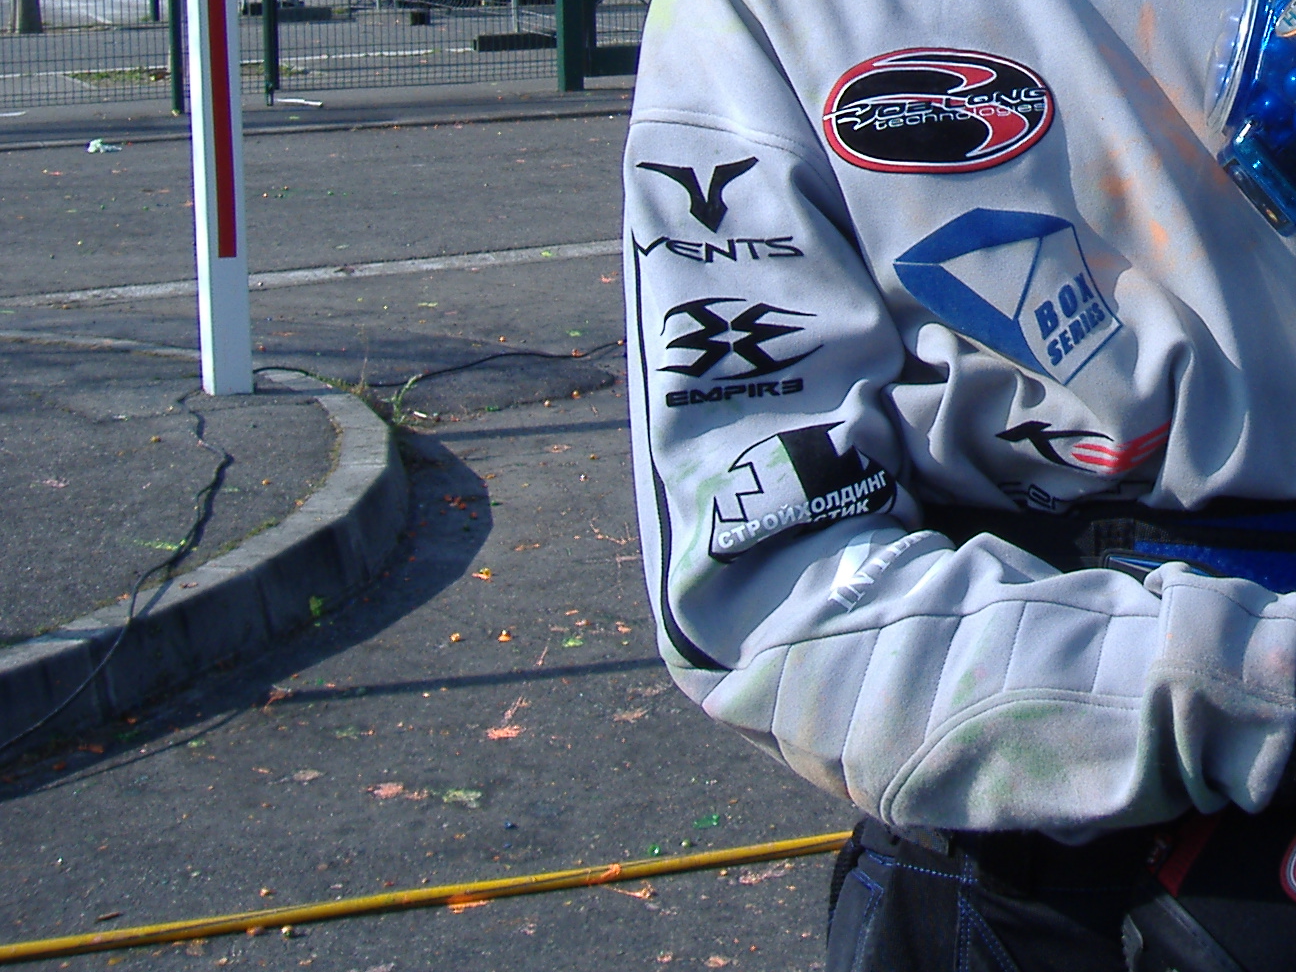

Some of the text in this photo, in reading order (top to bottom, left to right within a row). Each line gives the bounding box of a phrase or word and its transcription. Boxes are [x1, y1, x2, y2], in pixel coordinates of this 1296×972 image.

[631, 230, 805, 263] VENTS
[1034, 272, 1095, 341] BOX
[1046, 302, 1106, 367] SERIES
